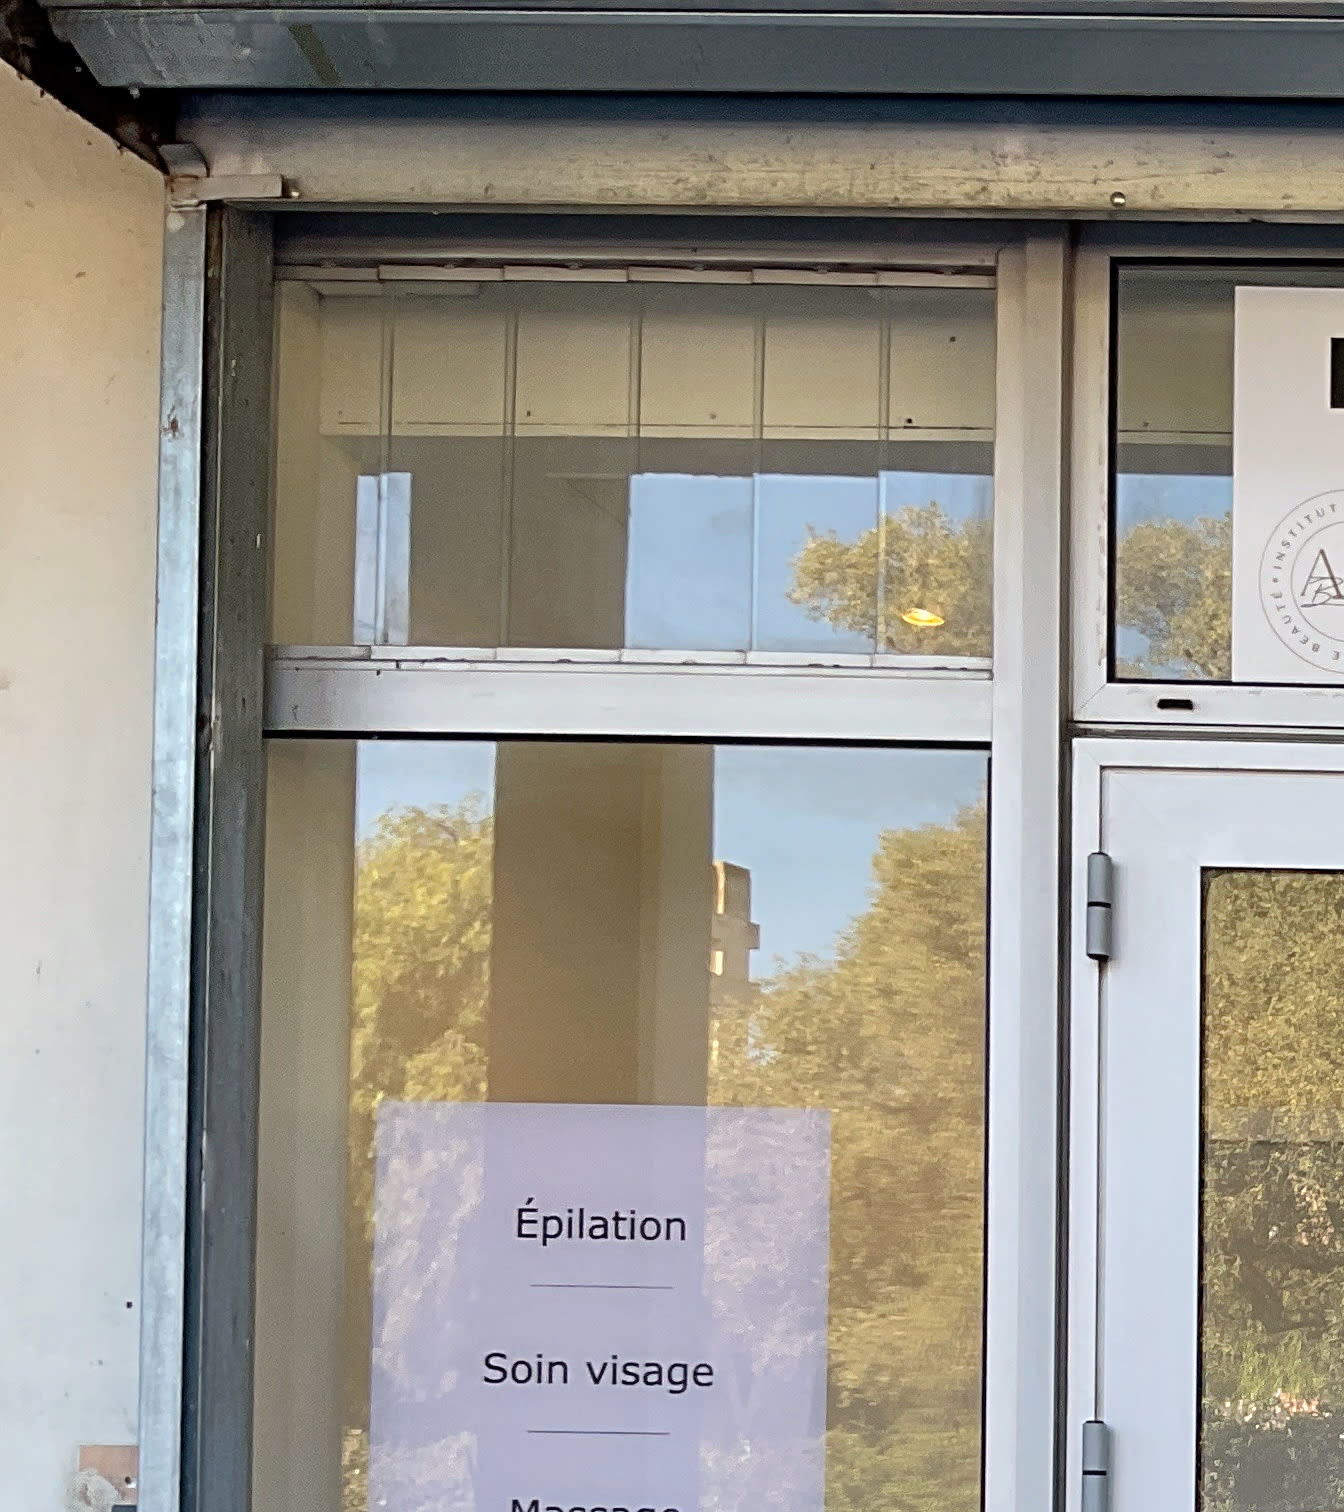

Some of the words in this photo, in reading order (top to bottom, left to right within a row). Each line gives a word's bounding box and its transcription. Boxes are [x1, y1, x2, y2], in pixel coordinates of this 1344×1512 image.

[1273, 504, 1336, 570] INSTITUT
[518, 1198, 685, 1246] Épilation
[484, 1353, 567, 1384] Soin
[587, 1355, 713, 1394] visage
